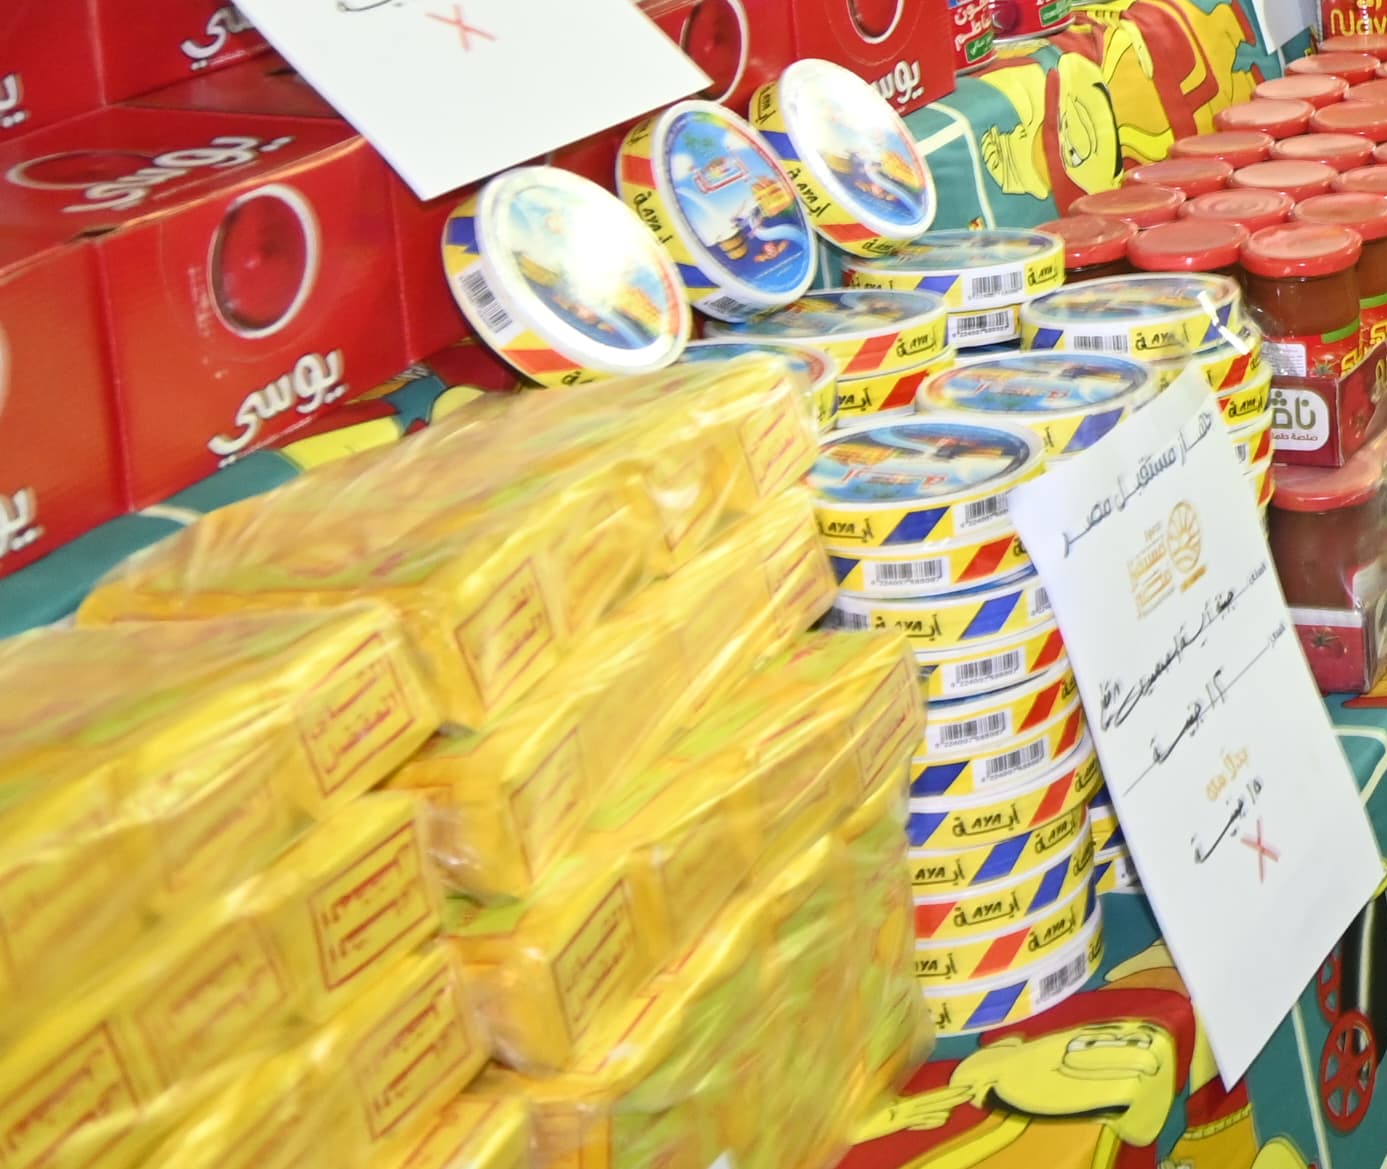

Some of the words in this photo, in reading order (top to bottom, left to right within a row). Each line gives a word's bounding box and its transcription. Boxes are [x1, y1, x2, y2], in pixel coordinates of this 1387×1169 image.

[208, 346, 350, 469] يوسي
[1178, 409, 1213, 468] جهاز
[1114, 445, 1178, 513] مستقبل
[1061, 496, 1113, 560] مصر
[971, 813, 1003, 831] AYA
[972, 900, 1004, 920] AYA
